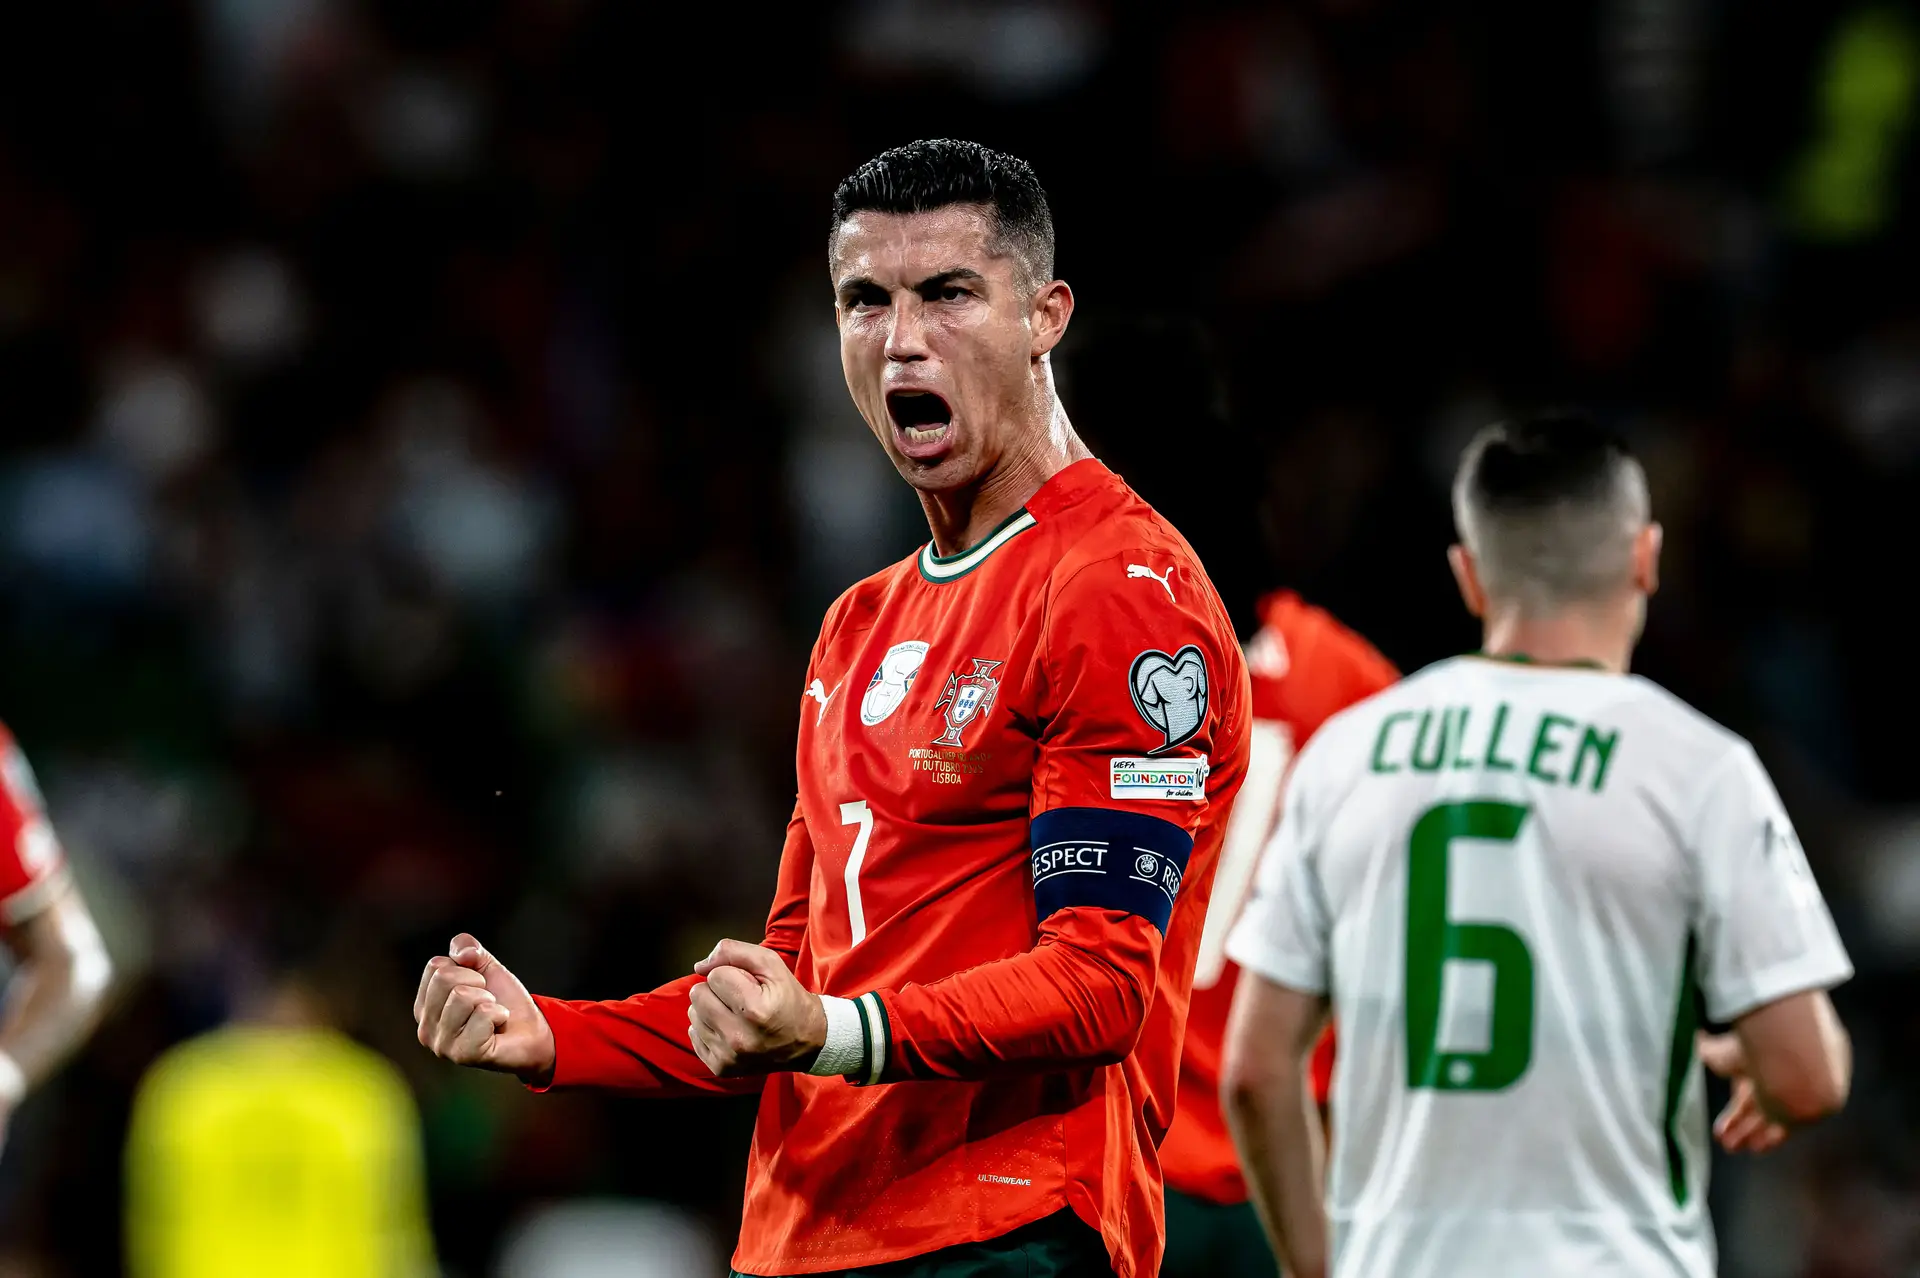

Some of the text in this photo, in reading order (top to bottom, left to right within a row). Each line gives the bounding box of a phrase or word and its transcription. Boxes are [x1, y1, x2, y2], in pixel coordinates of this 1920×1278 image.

[1370, 701, 1620, 793] CULLEN
[908, 748, 943, 760] PORTUGAL
[922, 760, 961, 773] OUTUBRO
[1113, 761, 1136, 769] UEFA
[932, 772, 962, 784] LISBOA
[1166, 788, 1175, 798] for
[839, 800, 874, 949] 7
[1406, 800, 1535, 1091] 6
[978, 1173, 1031, 1186] ULTRAWEAVE
